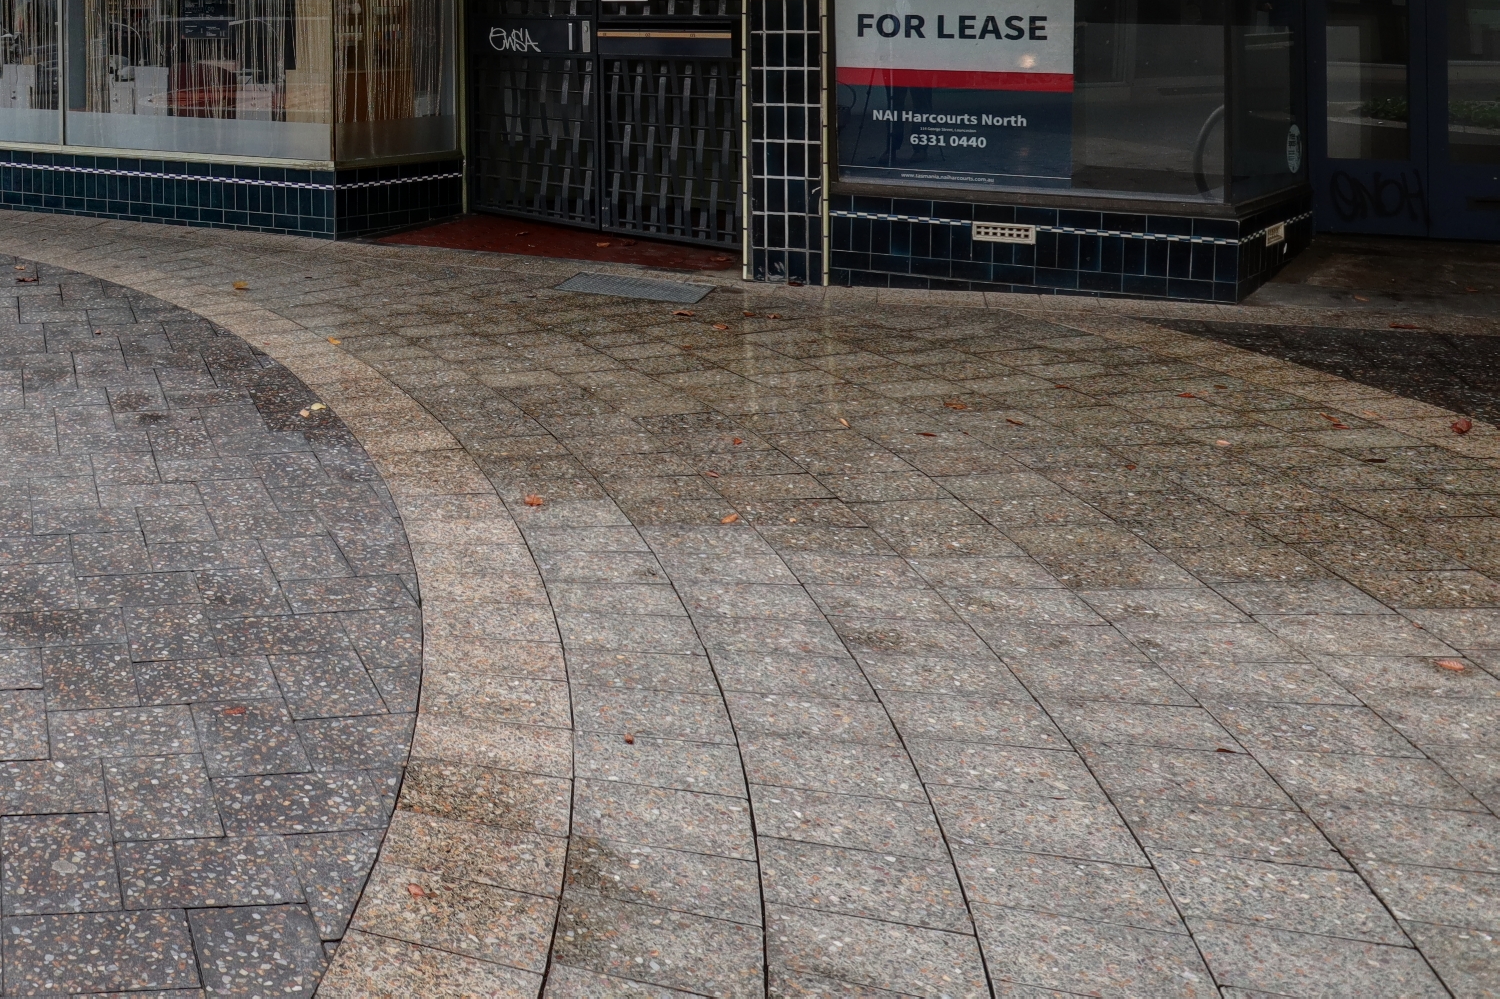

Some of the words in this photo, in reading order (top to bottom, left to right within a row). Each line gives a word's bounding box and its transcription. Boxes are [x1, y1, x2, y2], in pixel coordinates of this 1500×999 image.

[857, 13, 925, 38] FOR
[937, 14, 1048, 41] LEASE
[872, 109, 898, 122] NAI
[902, 110, 978, 125] Harcourts
[981, 114, 1027, 127] North
[910, 134, 946, 147] 6331
[949, 135, 987, 148] 0440
